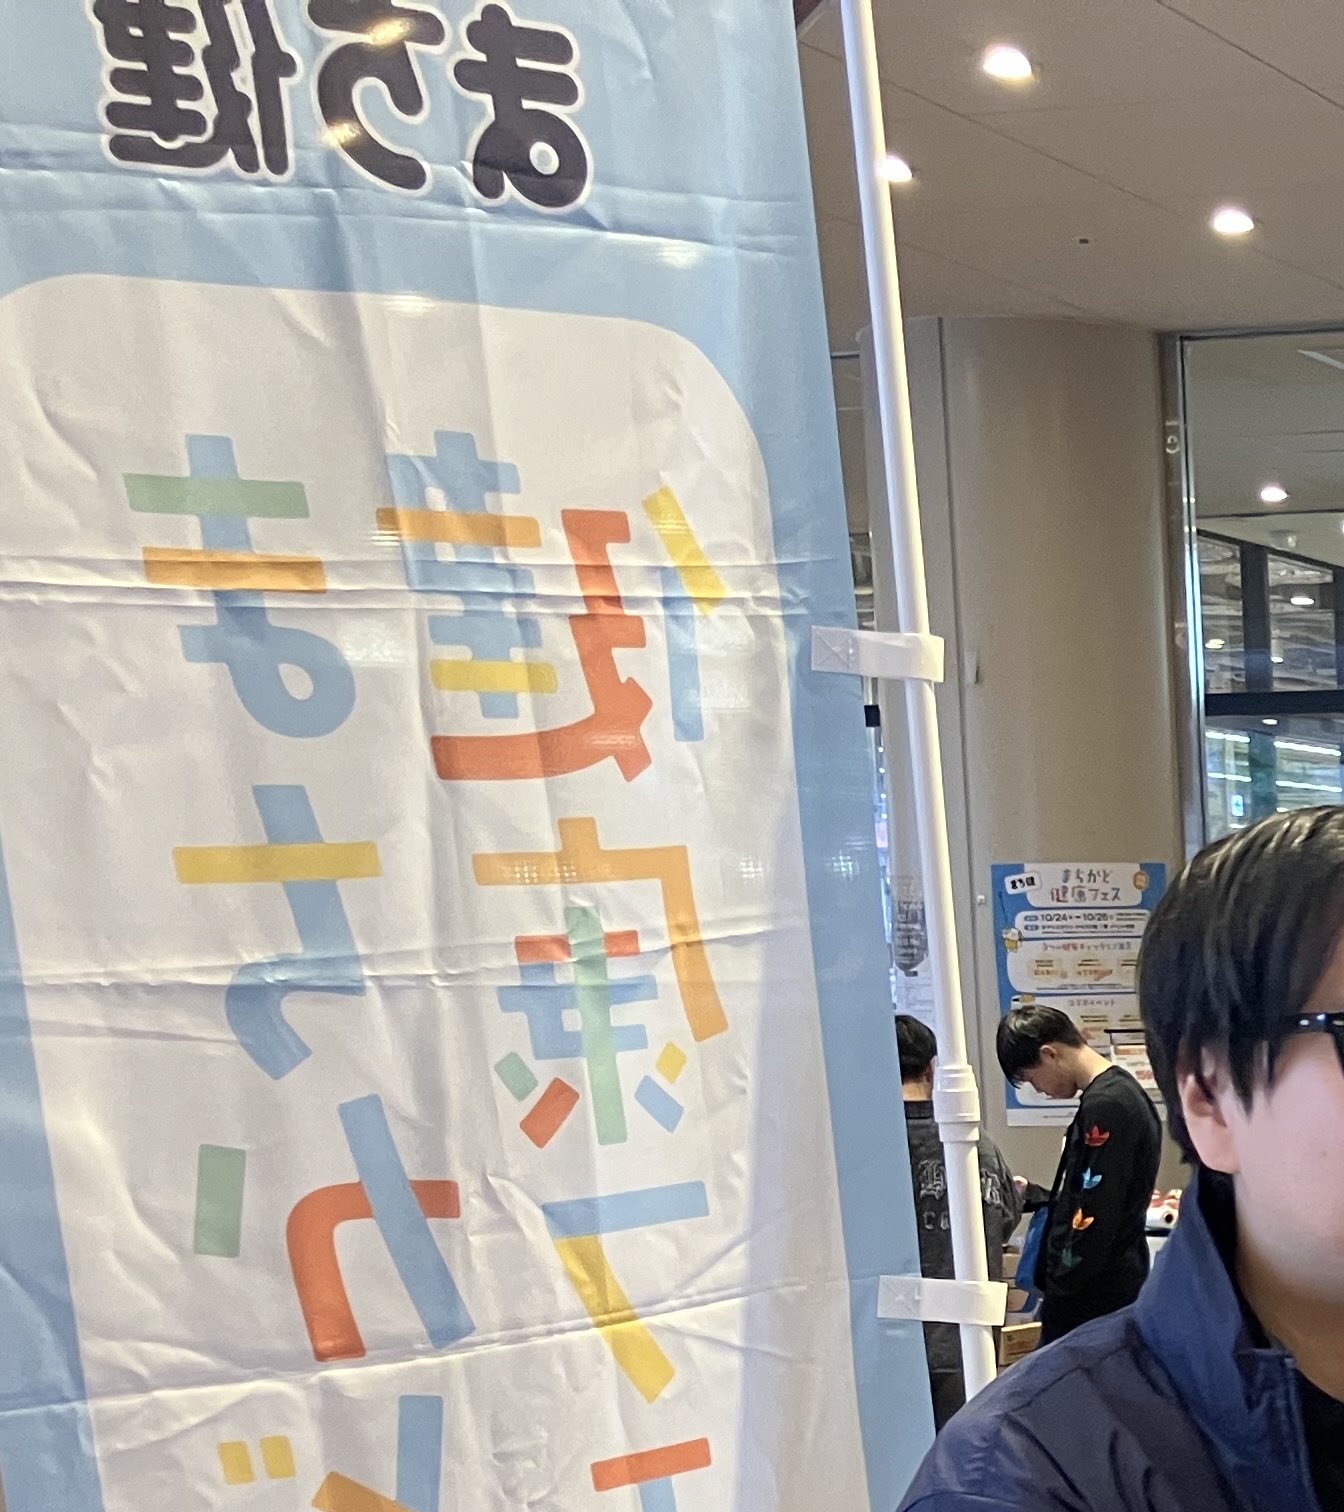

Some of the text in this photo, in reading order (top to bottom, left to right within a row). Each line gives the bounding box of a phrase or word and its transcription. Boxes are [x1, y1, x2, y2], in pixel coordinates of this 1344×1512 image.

[1050, 884, 1122, 904] 健康フェス
